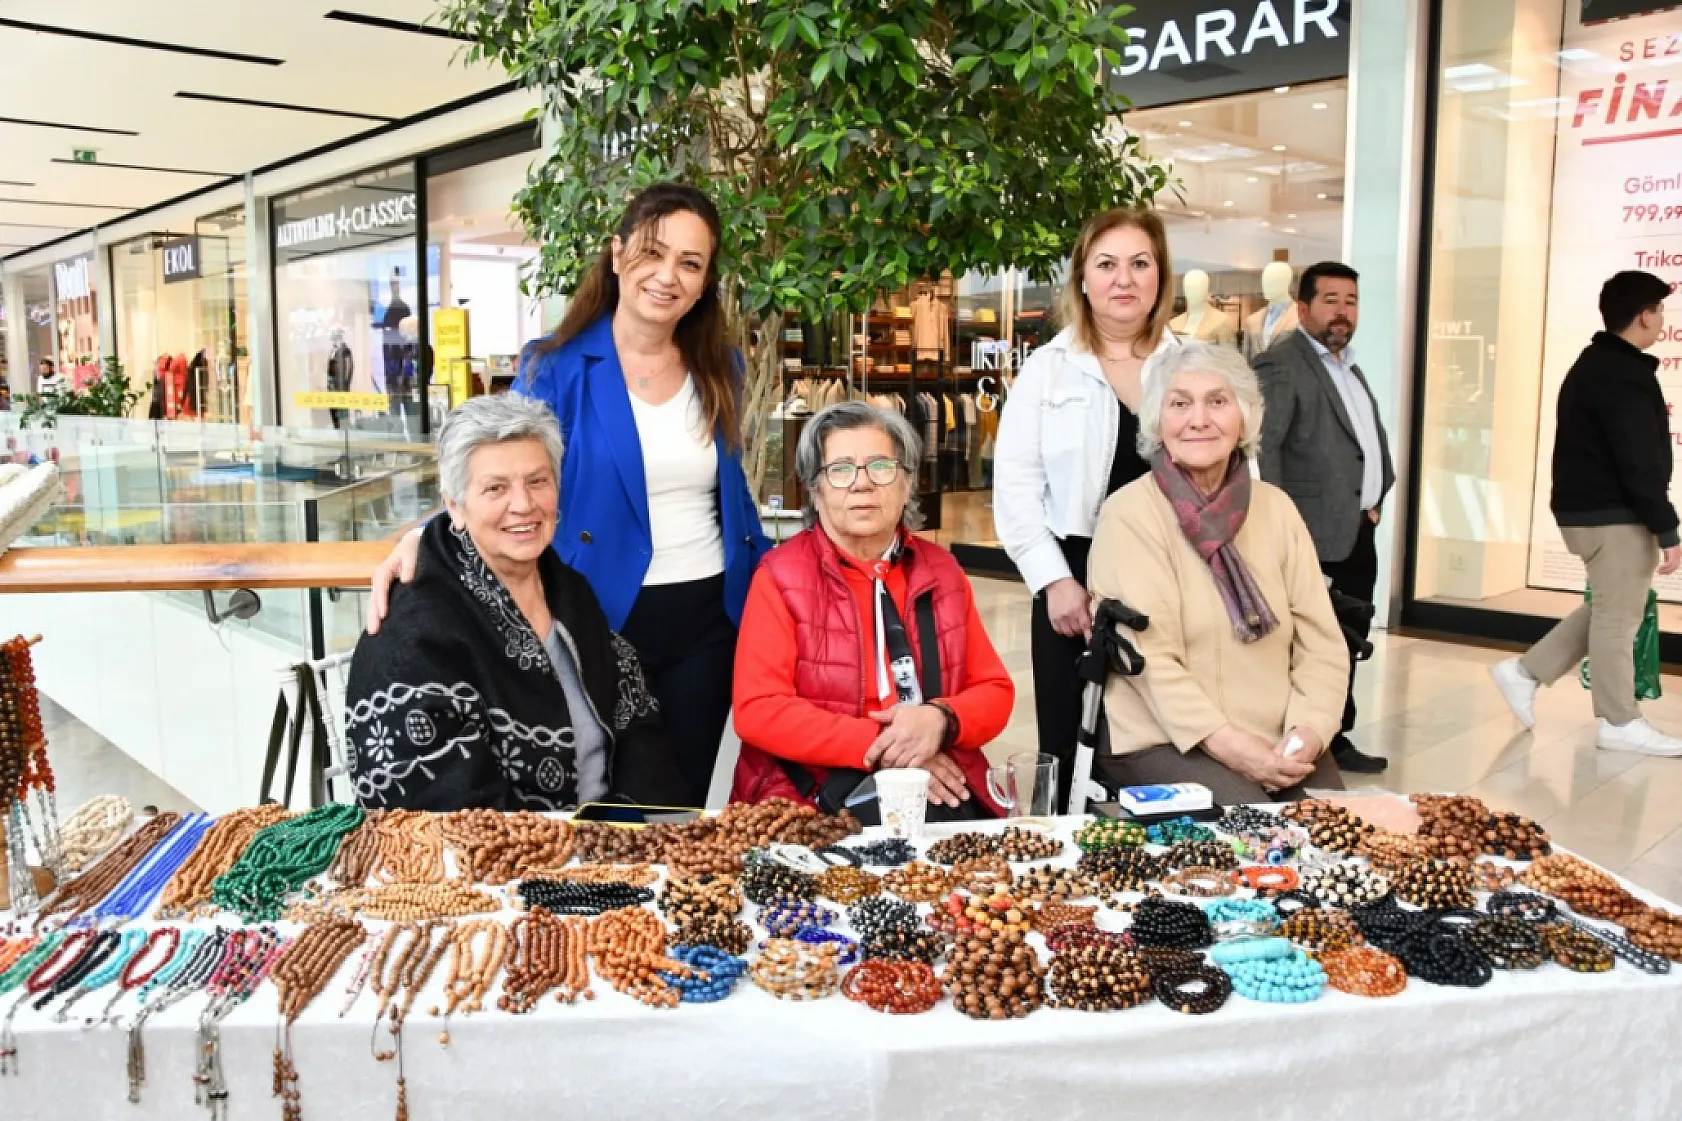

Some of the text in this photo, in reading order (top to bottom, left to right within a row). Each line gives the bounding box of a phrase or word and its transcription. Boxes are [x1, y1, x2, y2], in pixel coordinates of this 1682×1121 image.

[1111, 0, 1340, 76] SARAR
[1619, 36, 1680, 62] SEZ
[352, 193, 416, 231] CLASSICS
[164, 244, 196, 276] EKOL
